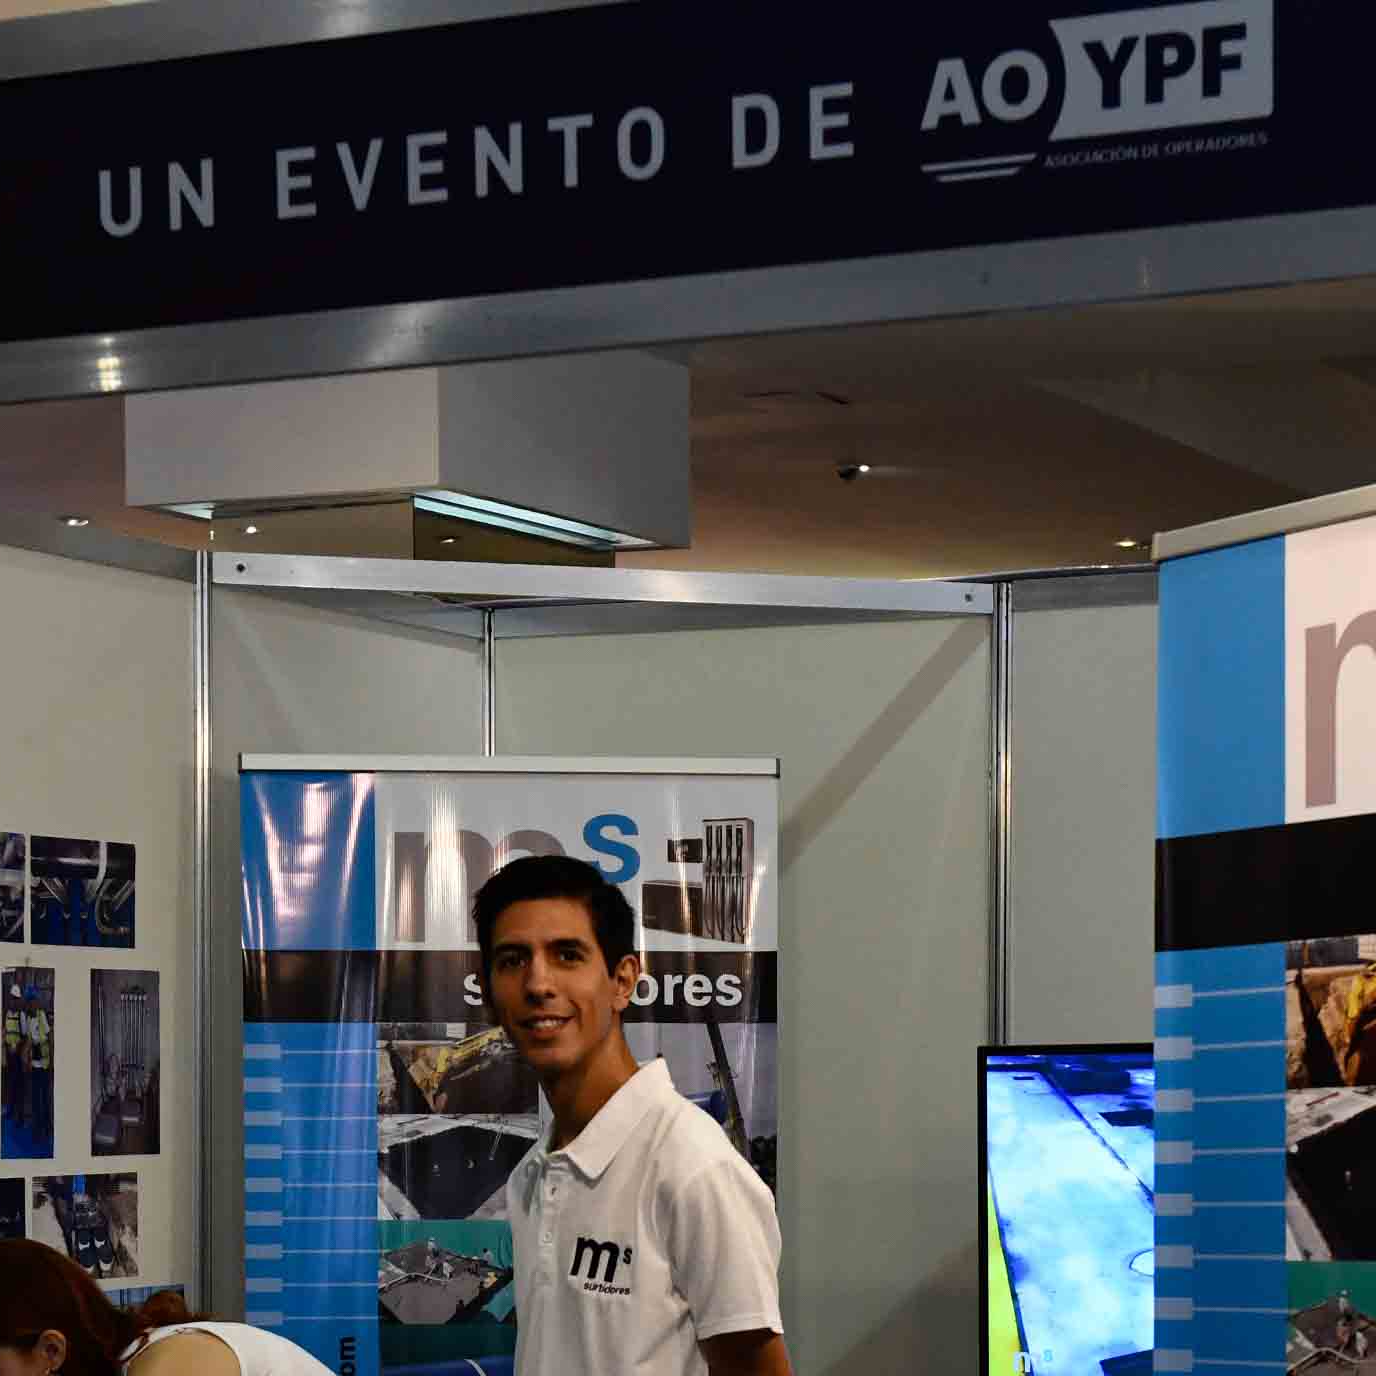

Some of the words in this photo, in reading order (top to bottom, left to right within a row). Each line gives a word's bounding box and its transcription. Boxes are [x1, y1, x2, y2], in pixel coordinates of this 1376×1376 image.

[99, 158, 214, 237] UN
[276, 106, 664, 220] EVENTO
[732, 82, 854, 168] DE
[583, 1281, 630, 1295] surtidores
